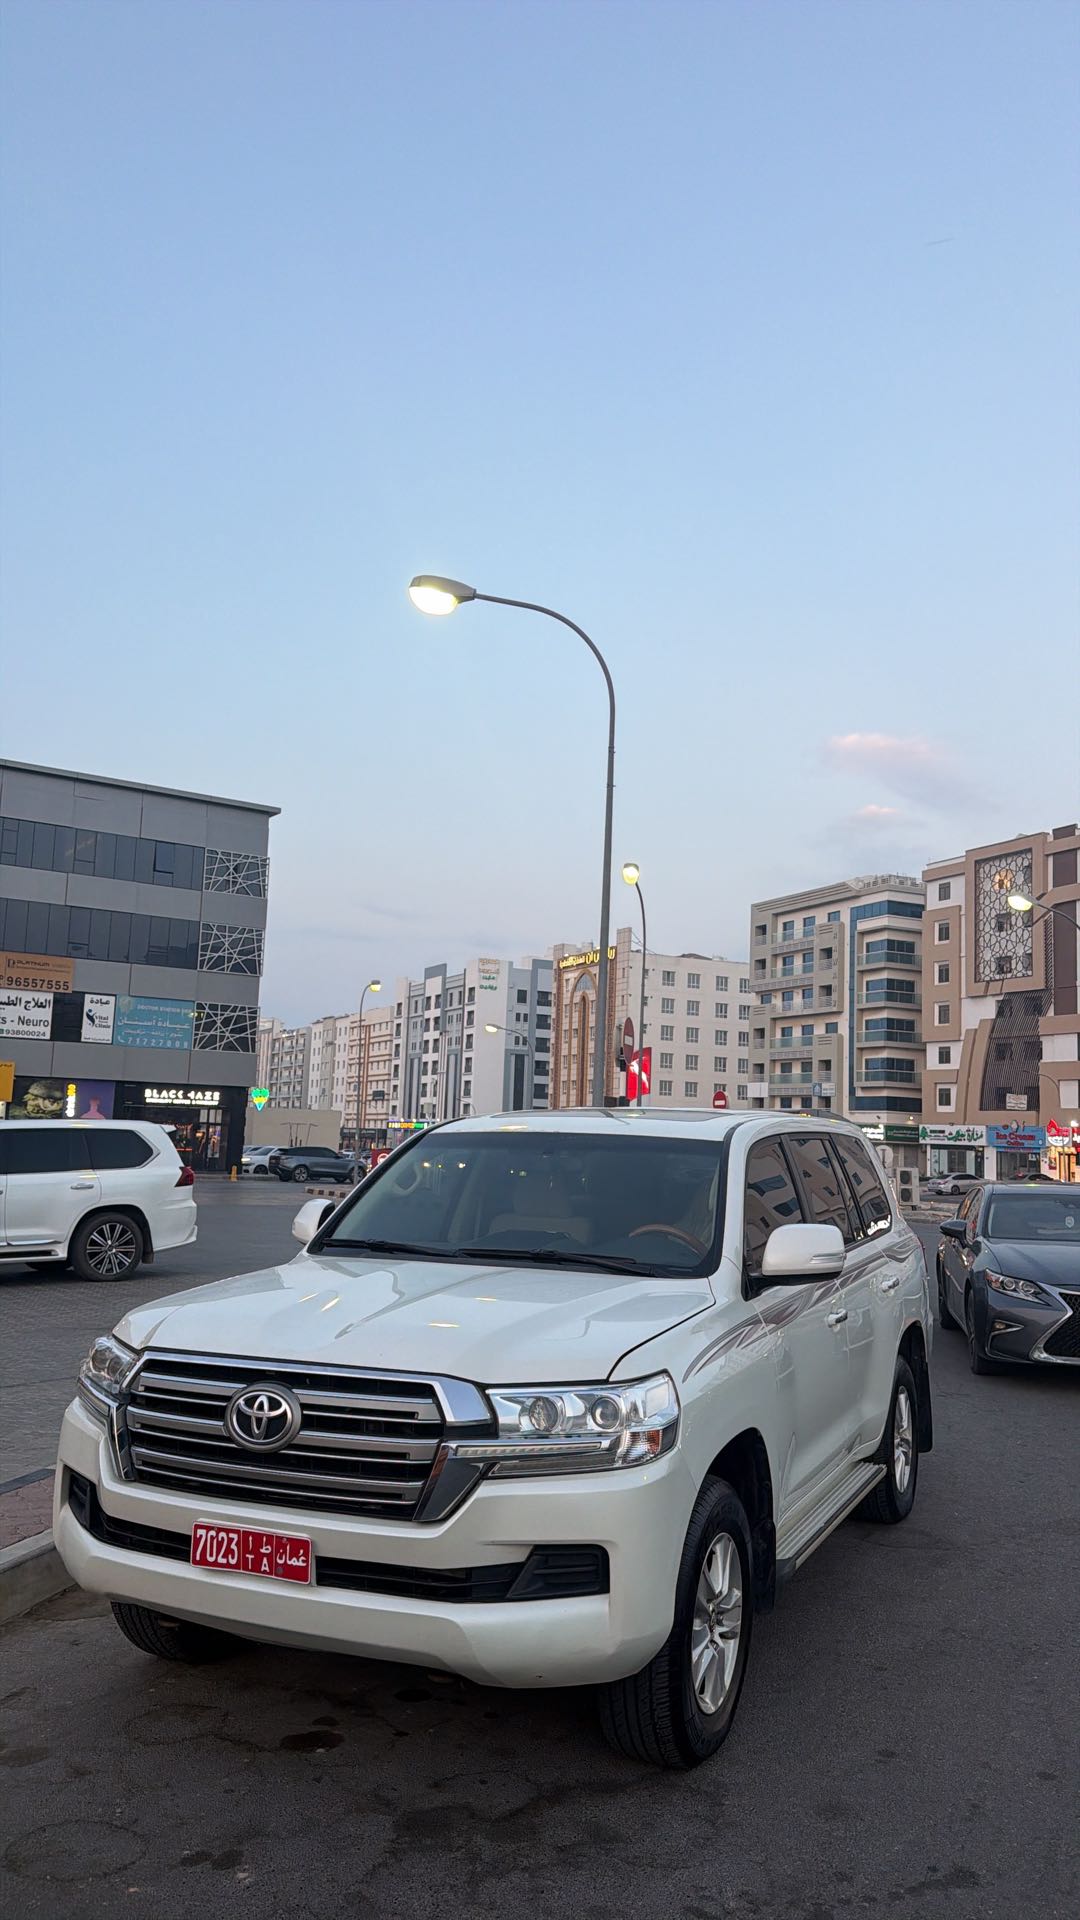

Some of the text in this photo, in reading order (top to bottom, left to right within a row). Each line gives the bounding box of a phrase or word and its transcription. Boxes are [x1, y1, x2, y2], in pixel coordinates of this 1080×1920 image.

[6, 976, 70, 991] 96557555
[0, 996, 51, 1011] العلاج الطبي
[17, 1015, 50, 1028] Neuro
[5, 1028, 46, 1038] 93800024
[144, 1088, 184, 1099] BLACK
[195, 1529, 239, 1565] 7023
